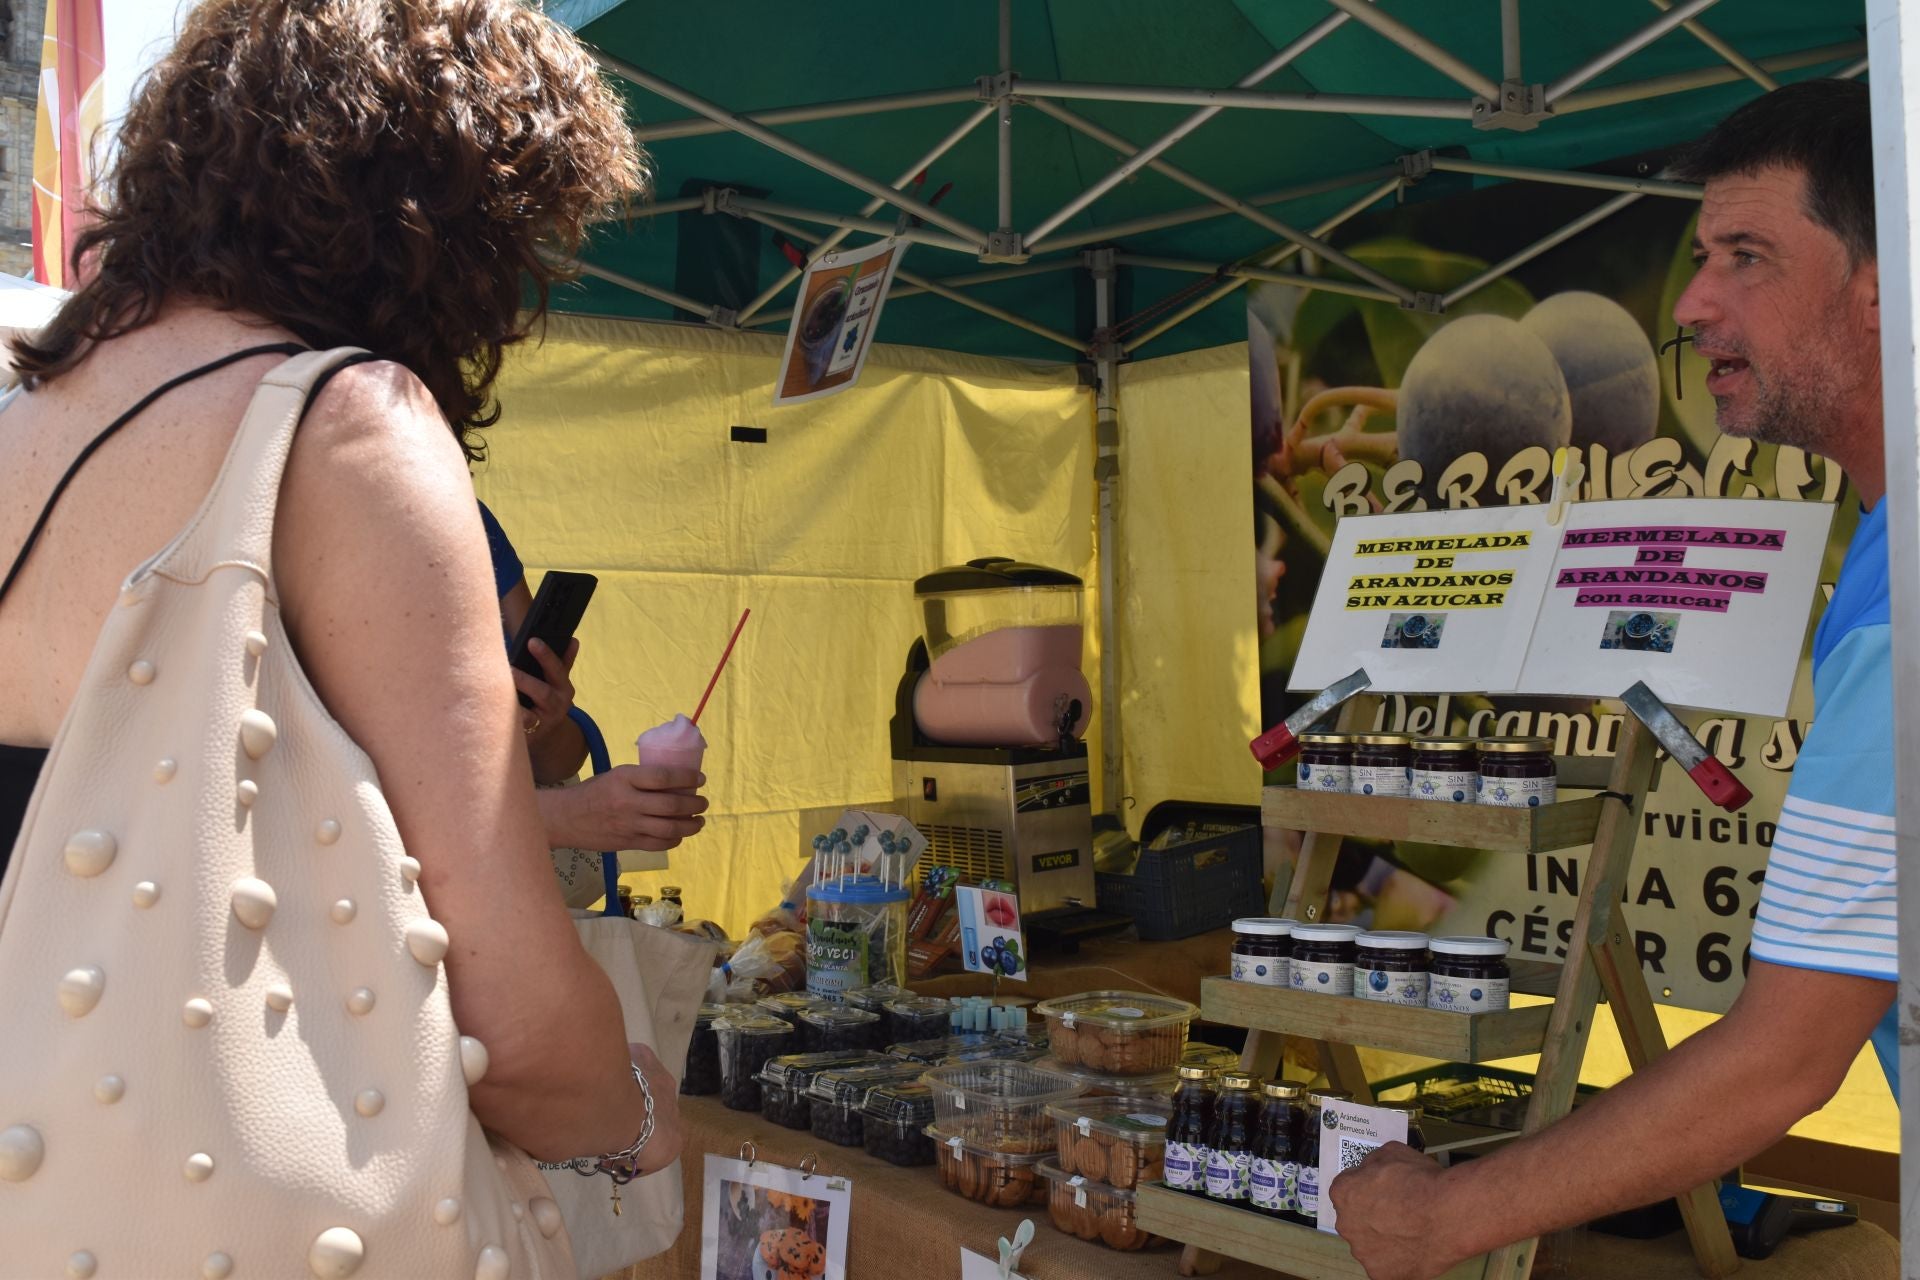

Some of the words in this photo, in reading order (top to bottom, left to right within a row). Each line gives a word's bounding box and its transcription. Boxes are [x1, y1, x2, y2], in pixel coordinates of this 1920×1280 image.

[1355, 535, 1530, 555] MERMELADA
[1564, 530, 1784, 548] MERMELADA
[1414, 557, 1455, 570] DE
[1635, 550, 1686, 563] DE
[1348, 573, 1514, 590] ARANDANOS
[1556, 571, 1767, 590] ARANDANOS
[1346, 595, 1390, 608] SIN
[1392, 593, 1505, 607] AZUCAR
[1575, 593, 1624, 605] con
[1628, 593, 1730, 609] azucar
[1760, 719, 1814, 771] s
[1447, 775, 1464, 783] SIN
[1522, 780, 1538, 789] SIN
[1644, 808, 1778, 847] rvicio
[1039, 854, 1072, 867] VEVOR
[1526, 853, 1677, 909] INA
[1486, 905, 1668, 974] CÉSR
[1696, 931, 1752, 983] 6
[827, 948, 854, 960] VECI
[1339, 1112, 1370, 1125] Arándanos
[1339, 1123, 1365, 1135] Berrueco
[1365, 1128, 1378, 1137] Veci
